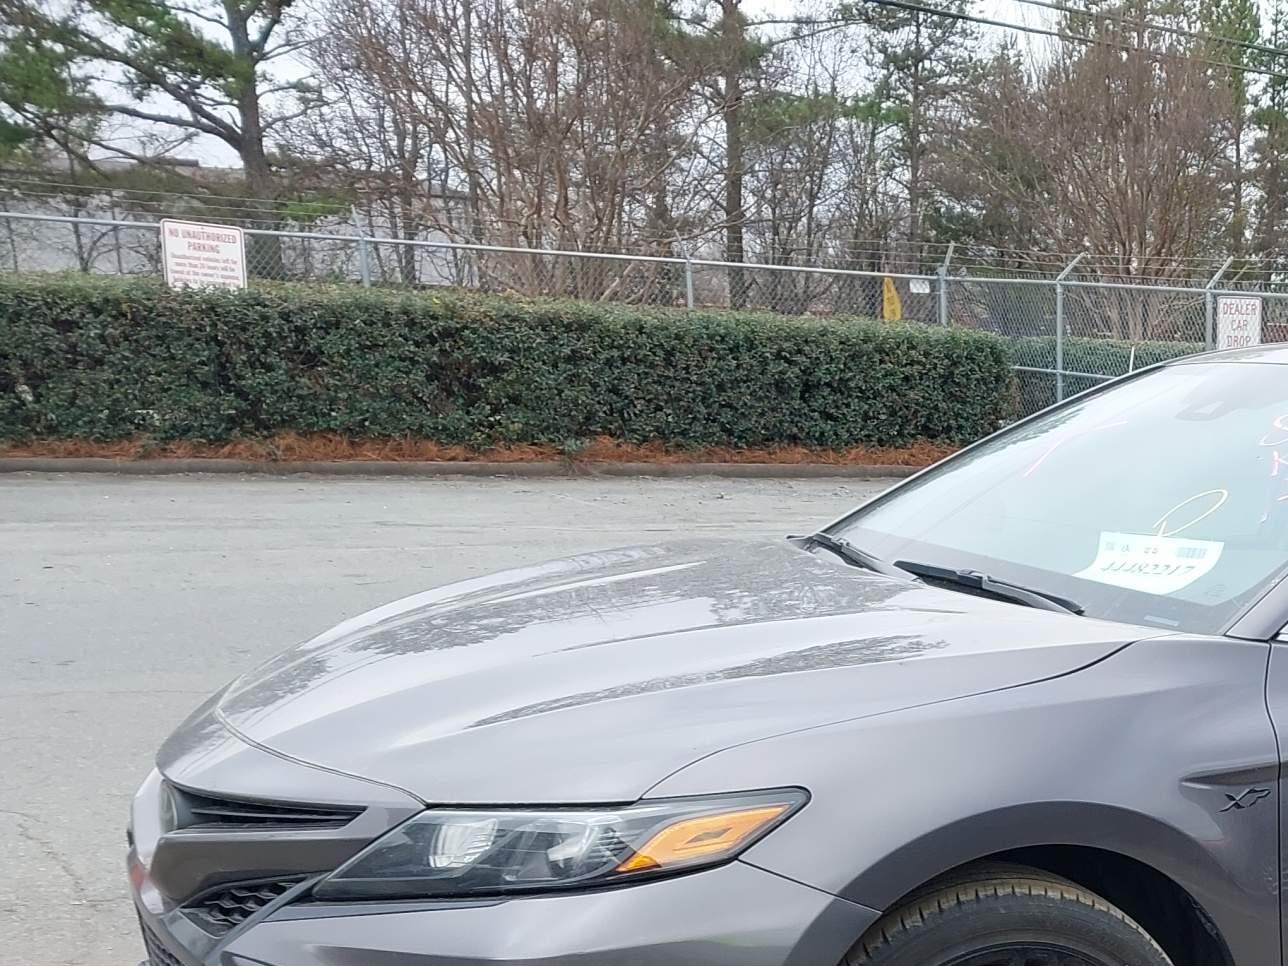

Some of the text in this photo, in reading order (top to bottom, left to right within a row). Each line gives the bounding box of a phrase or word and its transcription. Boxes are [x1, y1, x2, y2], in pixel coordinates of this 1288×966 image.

[168, 228, 237, 244] NO UNAUTHORIZED
[187, 241, 220, 254] PARKING
[1223, 302, 1257, 316] DEALER
[1231, 319, 1248, 331] CAR
[1226, 335, 1252, 347] DROP
